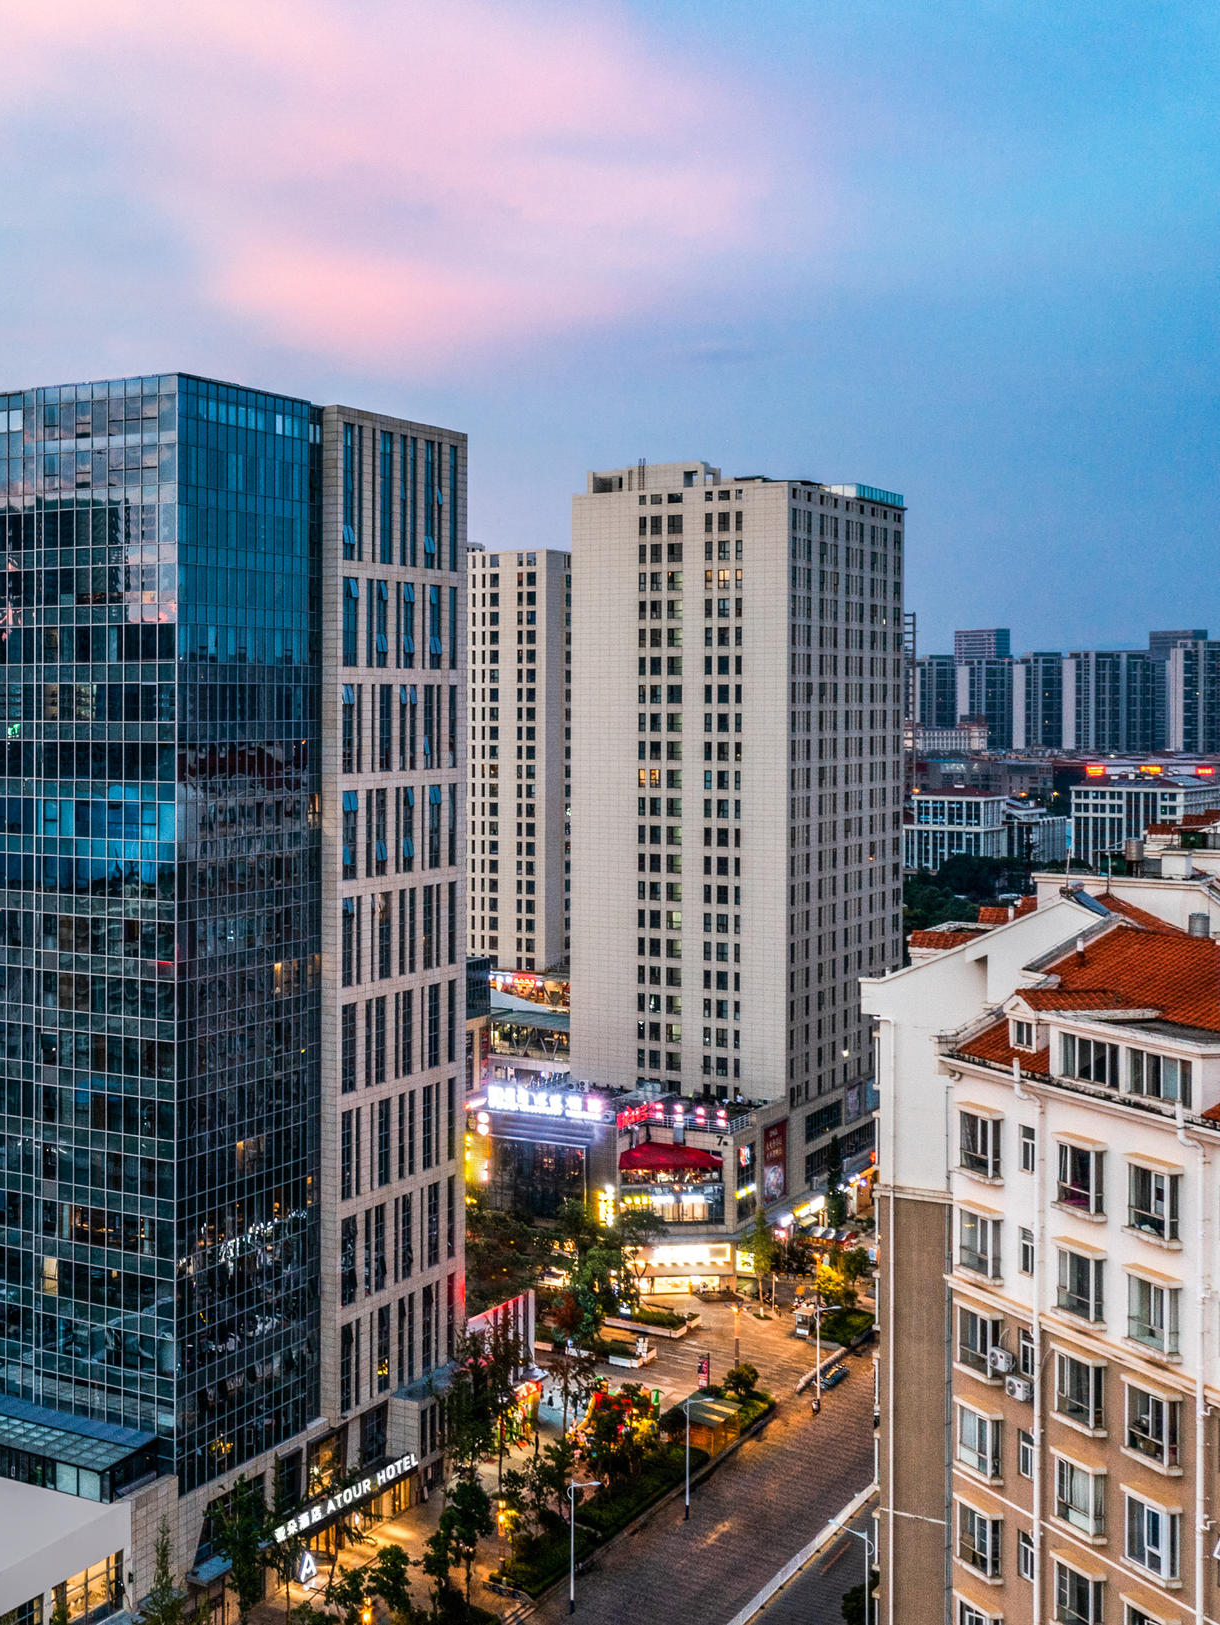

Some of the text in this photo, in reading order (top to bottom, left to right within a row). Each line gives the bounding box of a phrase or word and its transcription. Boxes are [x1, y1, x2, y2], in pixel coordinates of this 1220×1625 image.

[274, 1453, 419, 1544] 亚朵酒店 ATOUR HOTEL
